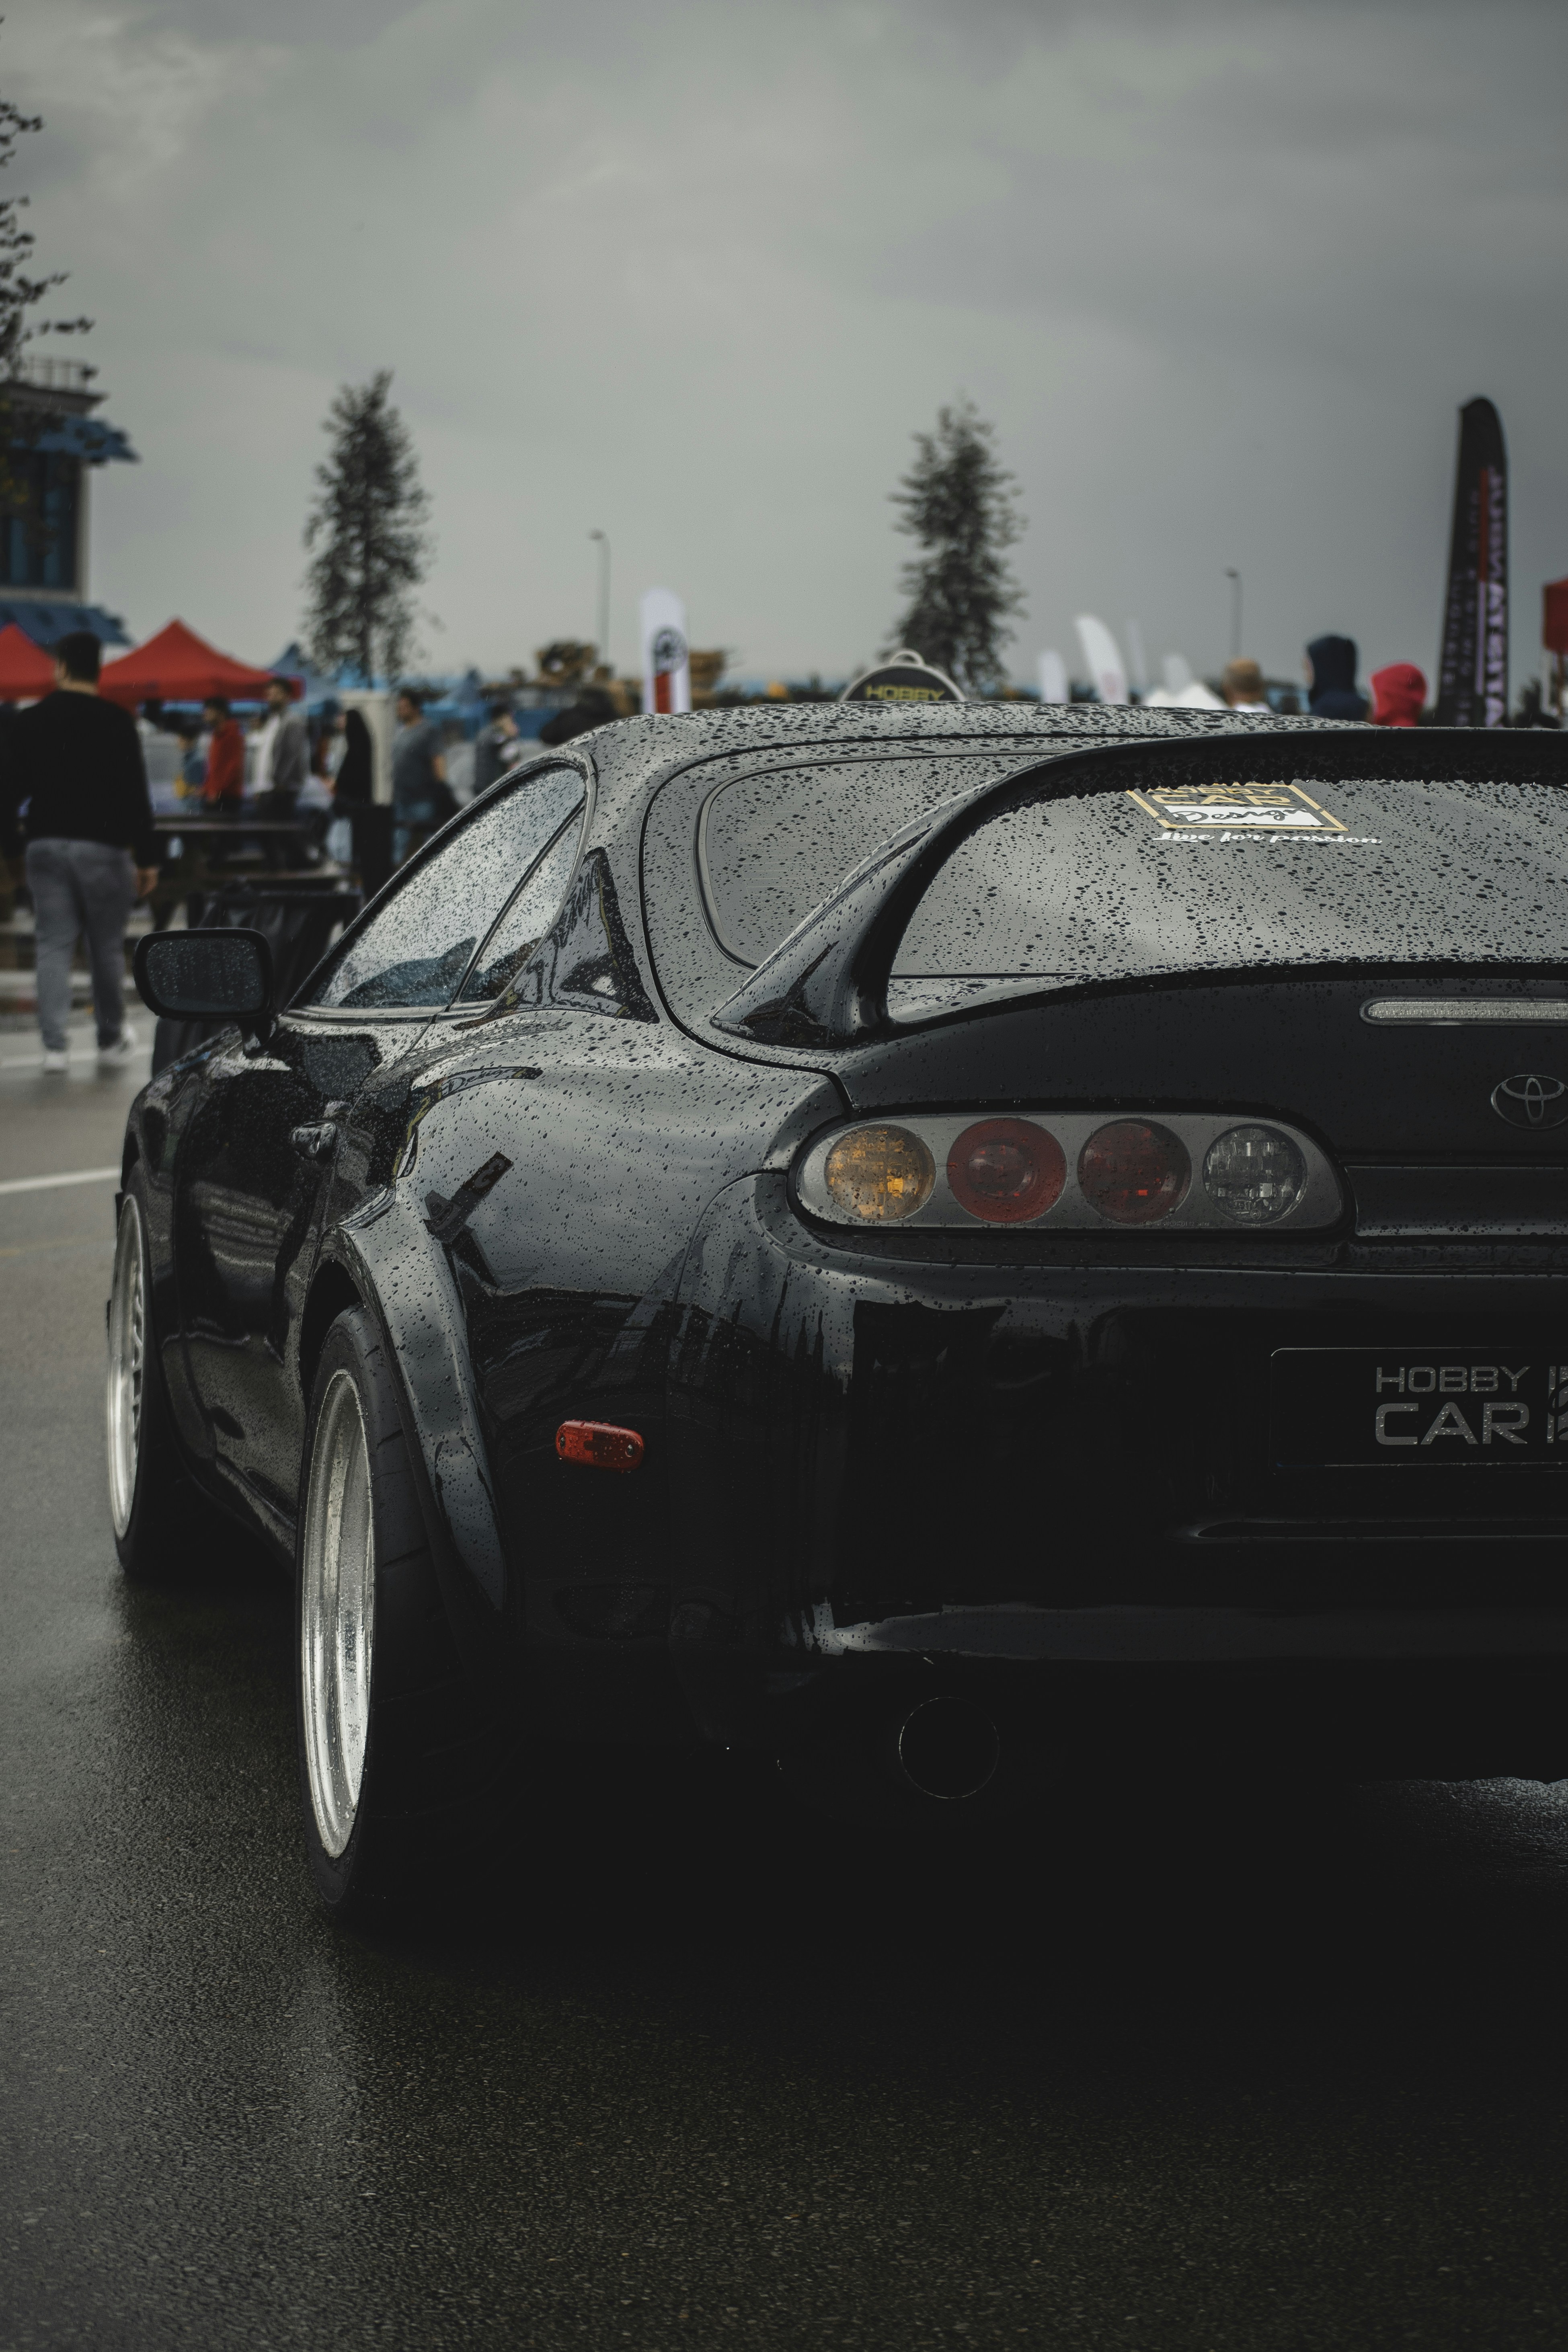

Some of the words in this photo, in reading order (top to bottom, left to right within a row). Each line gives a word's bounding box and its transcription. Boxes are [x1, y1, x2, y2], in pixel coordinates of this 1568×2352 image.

[866, 685, 945, 701] HOBBY
[1152, 795, 1295, 806] CAR
[1172, 809, 1308, 822] Design
[1153, 832, 1215, 842] Live
[1220, 832, 1265, 842] for
[1376, 1367, 1531, 1392] HOBBY
[1375, 1402, 1529, 1445] CAR
